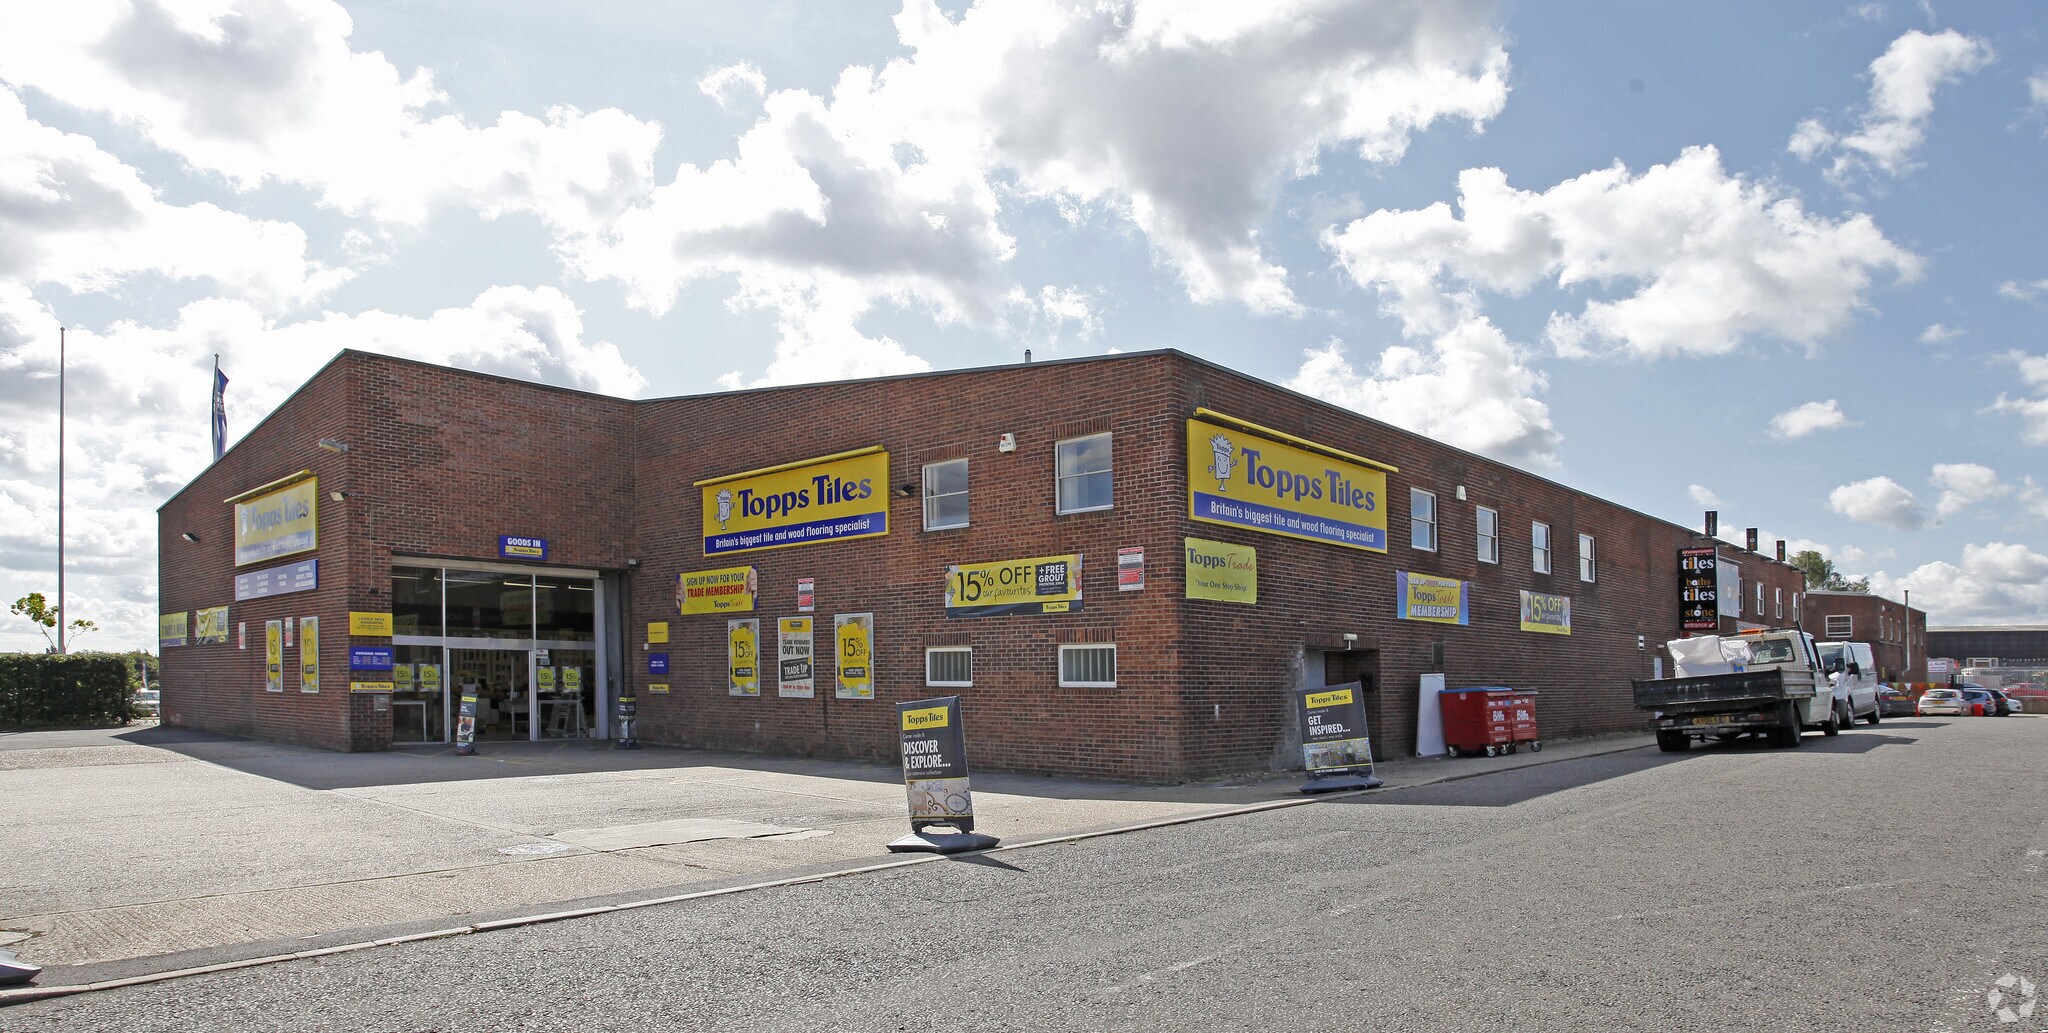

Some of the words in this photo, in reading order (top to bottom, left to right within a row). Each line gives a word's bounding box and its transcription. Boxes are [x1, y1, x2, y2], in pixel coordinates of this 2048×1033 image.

[1242, 447, 1322, 502] Topps
[1324, 469, 1376, 512] Tiles
[738, 488, 810, 519] Topps
[812, 474, 872, 506] Tiles
[1211, 501, 1242, 518] Britain's
[1244, 509, 1272, 524] biggest
[1274, 513, 1285, 526] tile
[1287, 516, 1300, 529] and
[1301, 521, 1318, 532] wood
[1320, 521, 1345, 539] flooring
[1346, 526, 1374, 543] specialist
[716, 536, 739, 548] Britain's
[740, 532, 762, 546] biggest
[763, 531, 773, 542] tile
[774, 529, 786, 540] and
[788, 526, 805, 538] wood
[806, 523, 834, 536] flooring
[834, 518, 870, 534] specialist
[508, 538, 531, 546] GOODS
[1187, 548, 1226, 569] Topps
[1227, 553, 1253, 571] Trade
[1682, 557, 1714, 570] tiles
[686, 577, 698, 586] SIGN
[698, 576, 706, 585] UP
[706, 575, 719, 584] NOW
[720, 574, 730, 583] FOR
[730, 572, 744, 582] YOUR
[958, 569, 994, 602] 15%
[1000, 565, 1031, 585] OFF
[1039, 574, 1064, 583] GROUT
[1210, 580, 1222, 588] One
[1222, 582, 1234, 591] Stop
[687, 587, 704, 598] TRADE
[706, 584, 745, 596] MEMBERSHIP
[1412, 586, 1436, 603] Topps
[1683, 589, 1715, 601] tiles
[714, 600, 730, 608] Topps
[1410, 604, 1457, 618] MEMBERSHIP
[1530, 595, 1546, 621] 15%
[1548, 597, 1561, 612] OFF
[783, 646, 794, 655] OUT
[796, 646, 810, 655] NOW
[784, 666, 800, 676] TRADE
[800, 663, 808, 674] UP
[907, 715, 928, 724] Topps
[928, 713, 944, 722] Tiles
[1308, 716, 1321, 726] GET
[1309, 724, 1351, 735] INSPIRED...
[903, 740, 938, 754] DISCOVER
[905, 758, 910, 769] &
[911, 754, 951, 769] EXPLORE...
